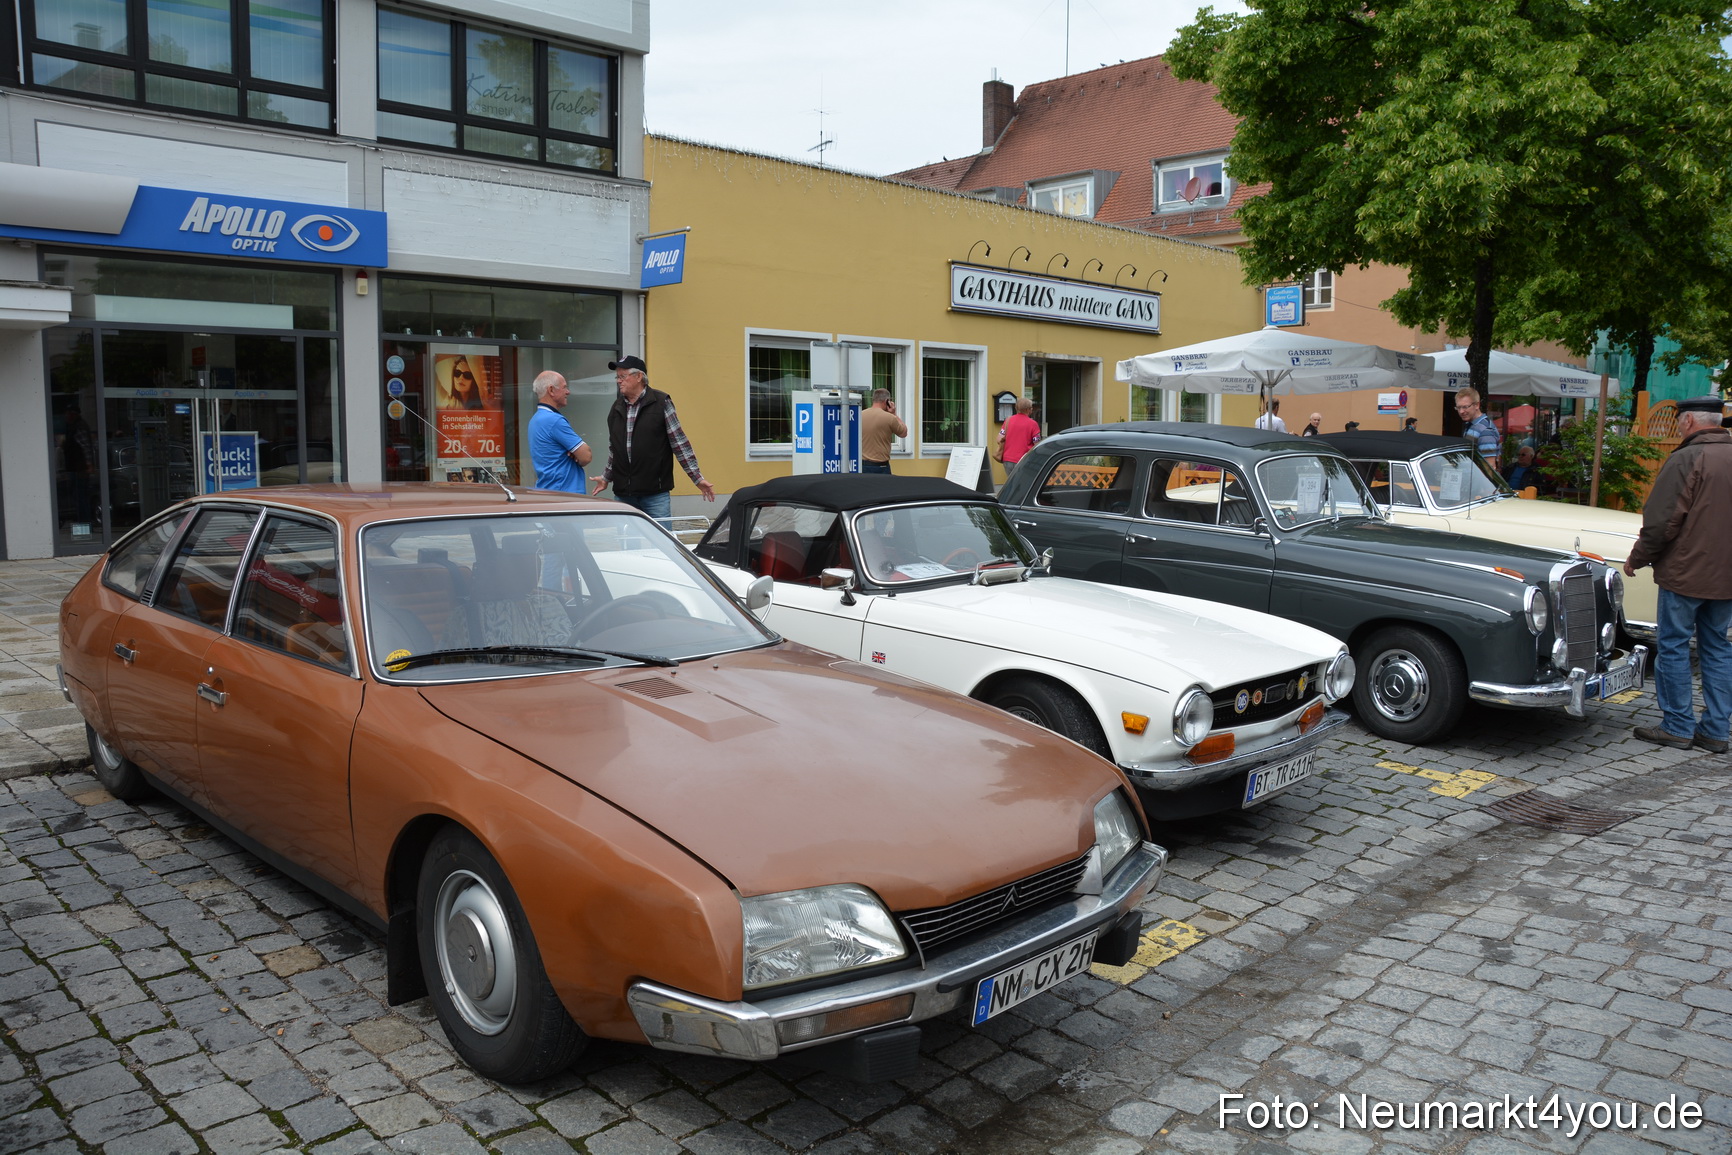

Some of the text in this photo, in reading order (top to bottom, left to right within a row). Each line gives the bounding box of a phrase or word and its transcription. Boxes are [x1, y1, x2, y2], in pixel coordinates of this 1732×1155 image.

[467, 73, 534, 105] Katrin
[179, 196, 287, 240] APOLLO
[231, 237, 278, 253] OPTIK
[645, 249, 680, 269] APOLLO
[659, 266, 675, 274] OPTIK
[959, 275, 1154, 321] GASTHAUS mittlere GANS
[799, 410, 810, 432] P
[827, 409, 855, 421] HIR
[450, 422, 484, 430] Sehstärke!
[1255, 755, 1314, 795] BT TR 611H
[989, 935, 1097, 1014] NM CX 2H
[979, 1005, 986, 1016] D
